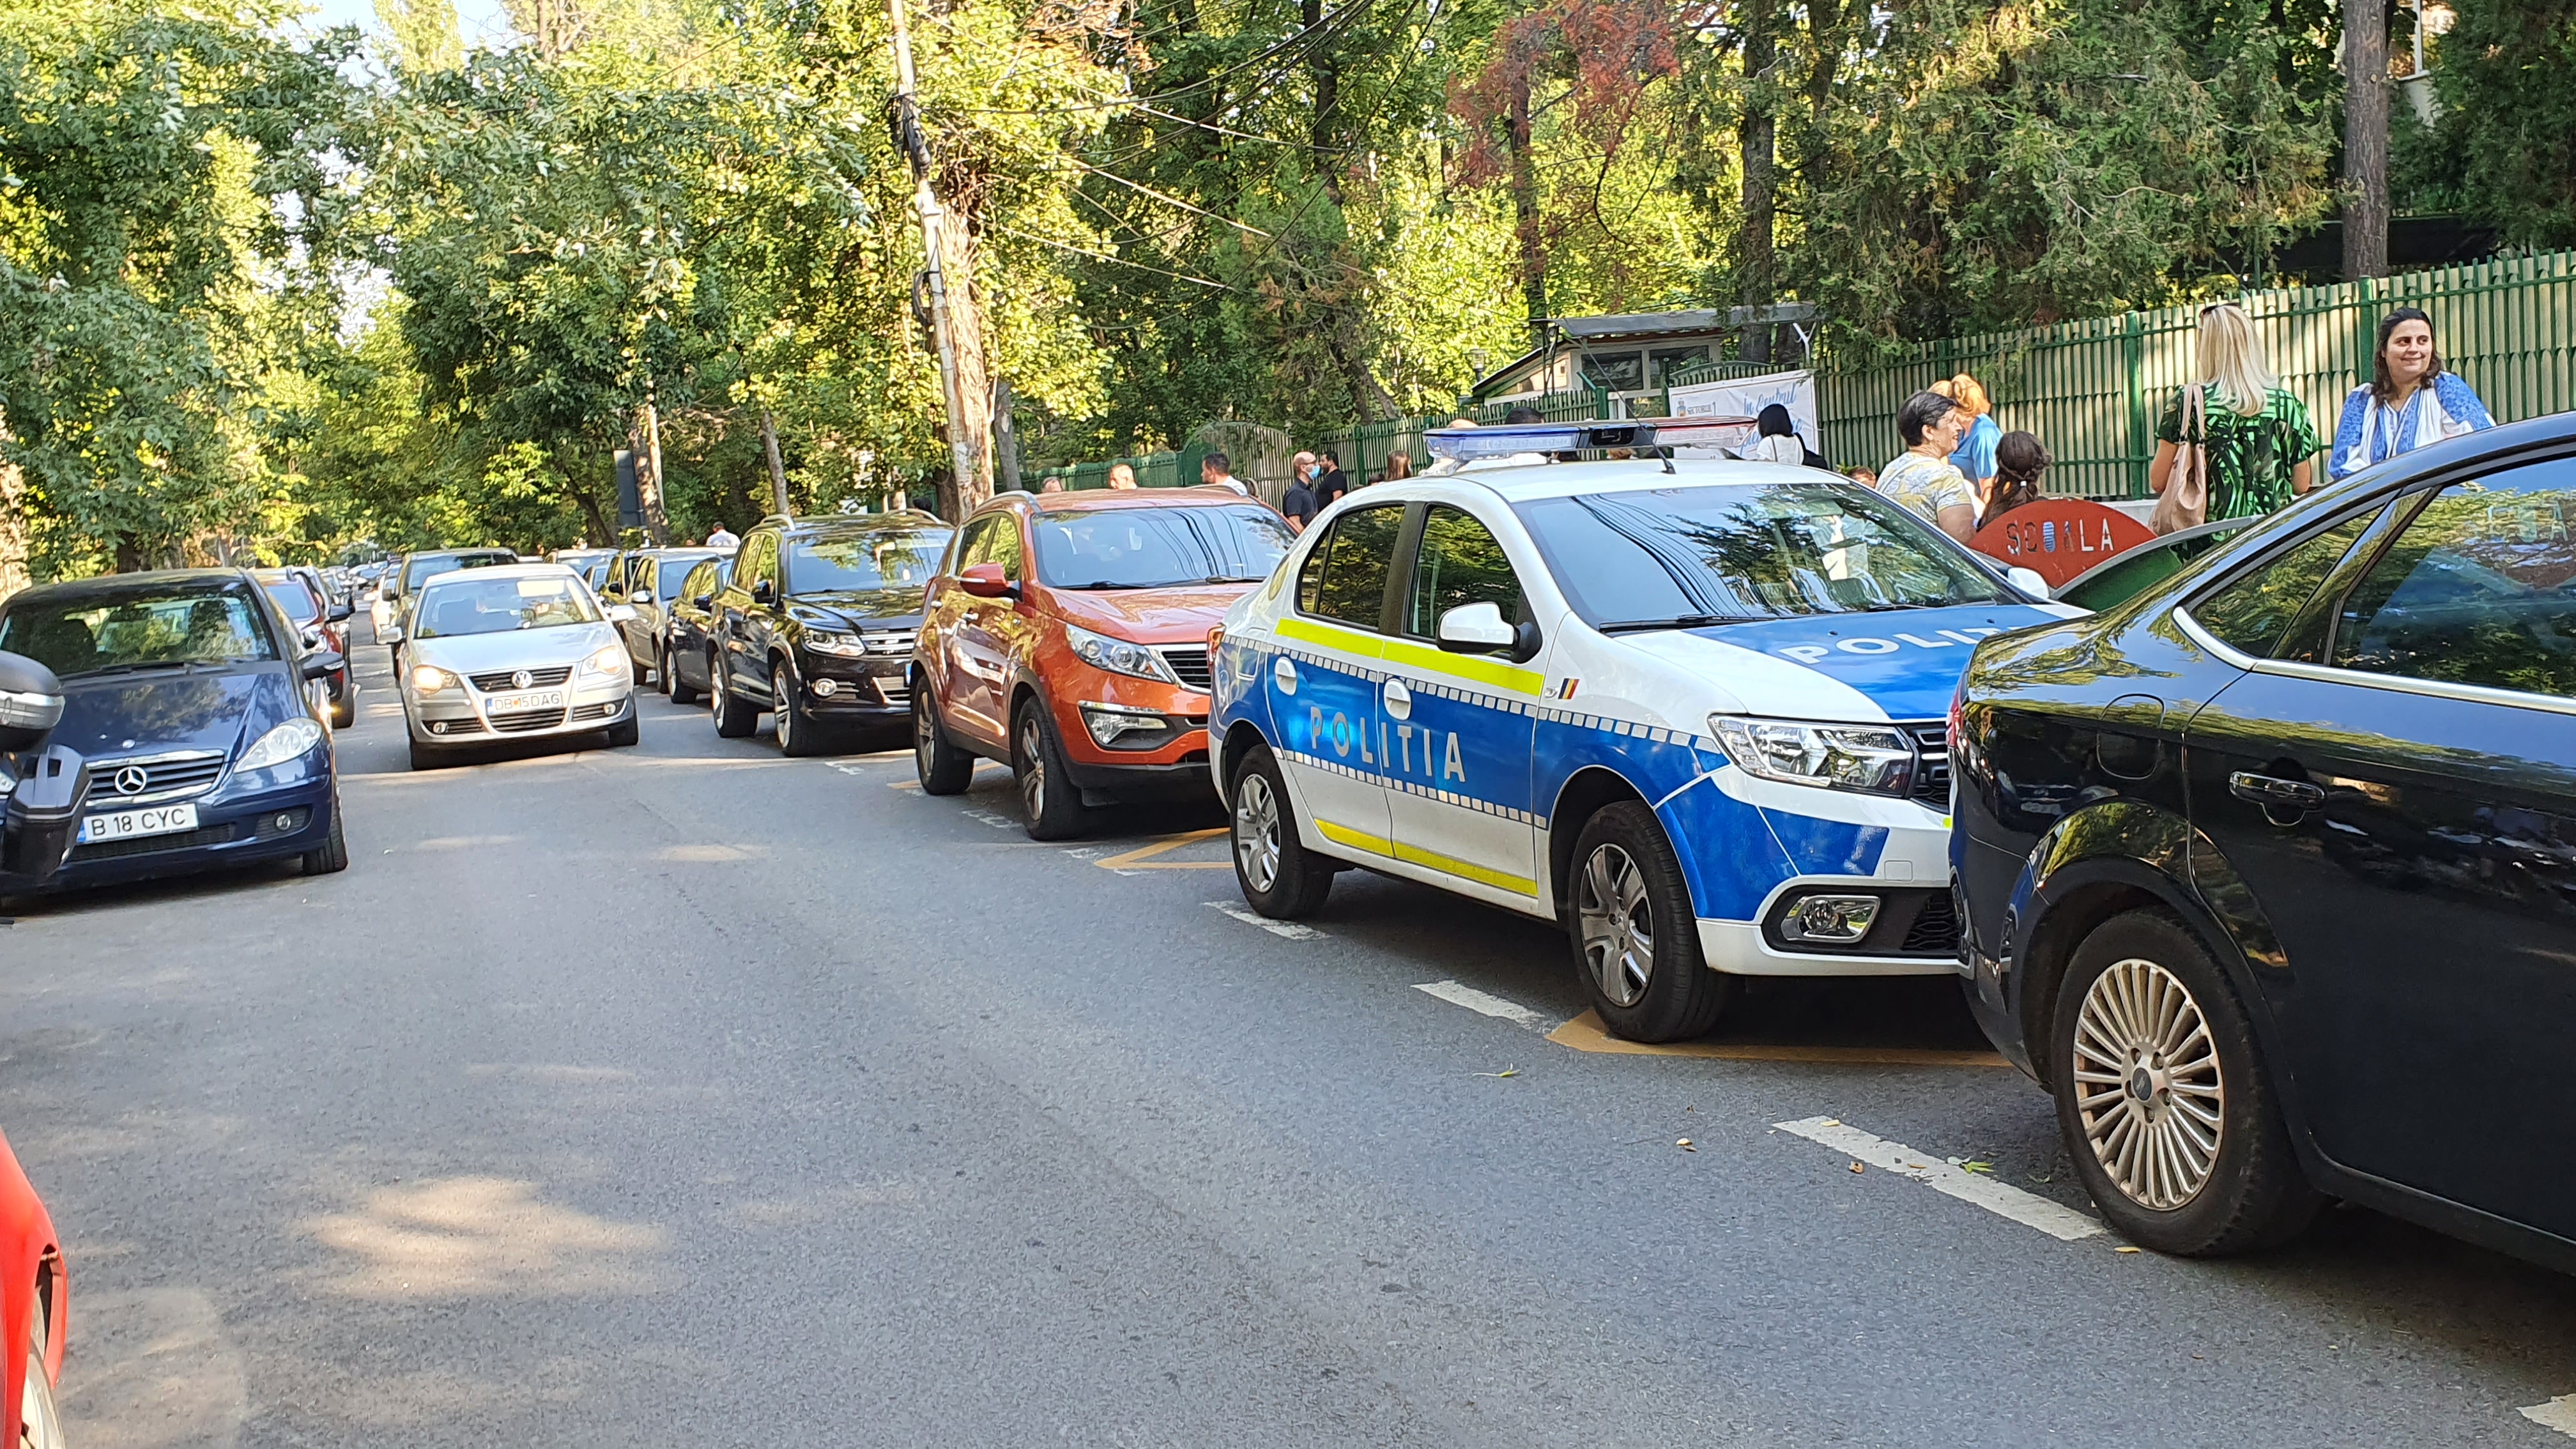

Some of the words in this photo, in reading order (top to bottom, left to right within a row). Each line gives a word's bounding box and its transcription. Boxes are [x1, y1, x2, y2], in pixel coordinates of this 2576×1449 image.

[517, 696, 529, 708] 15
[1310, 706, 1466, 783] POLITIA
[91, 818, 106, 836] B
[113, 815, 133, 834] 18
[141, 808, 186, 829] CYC
